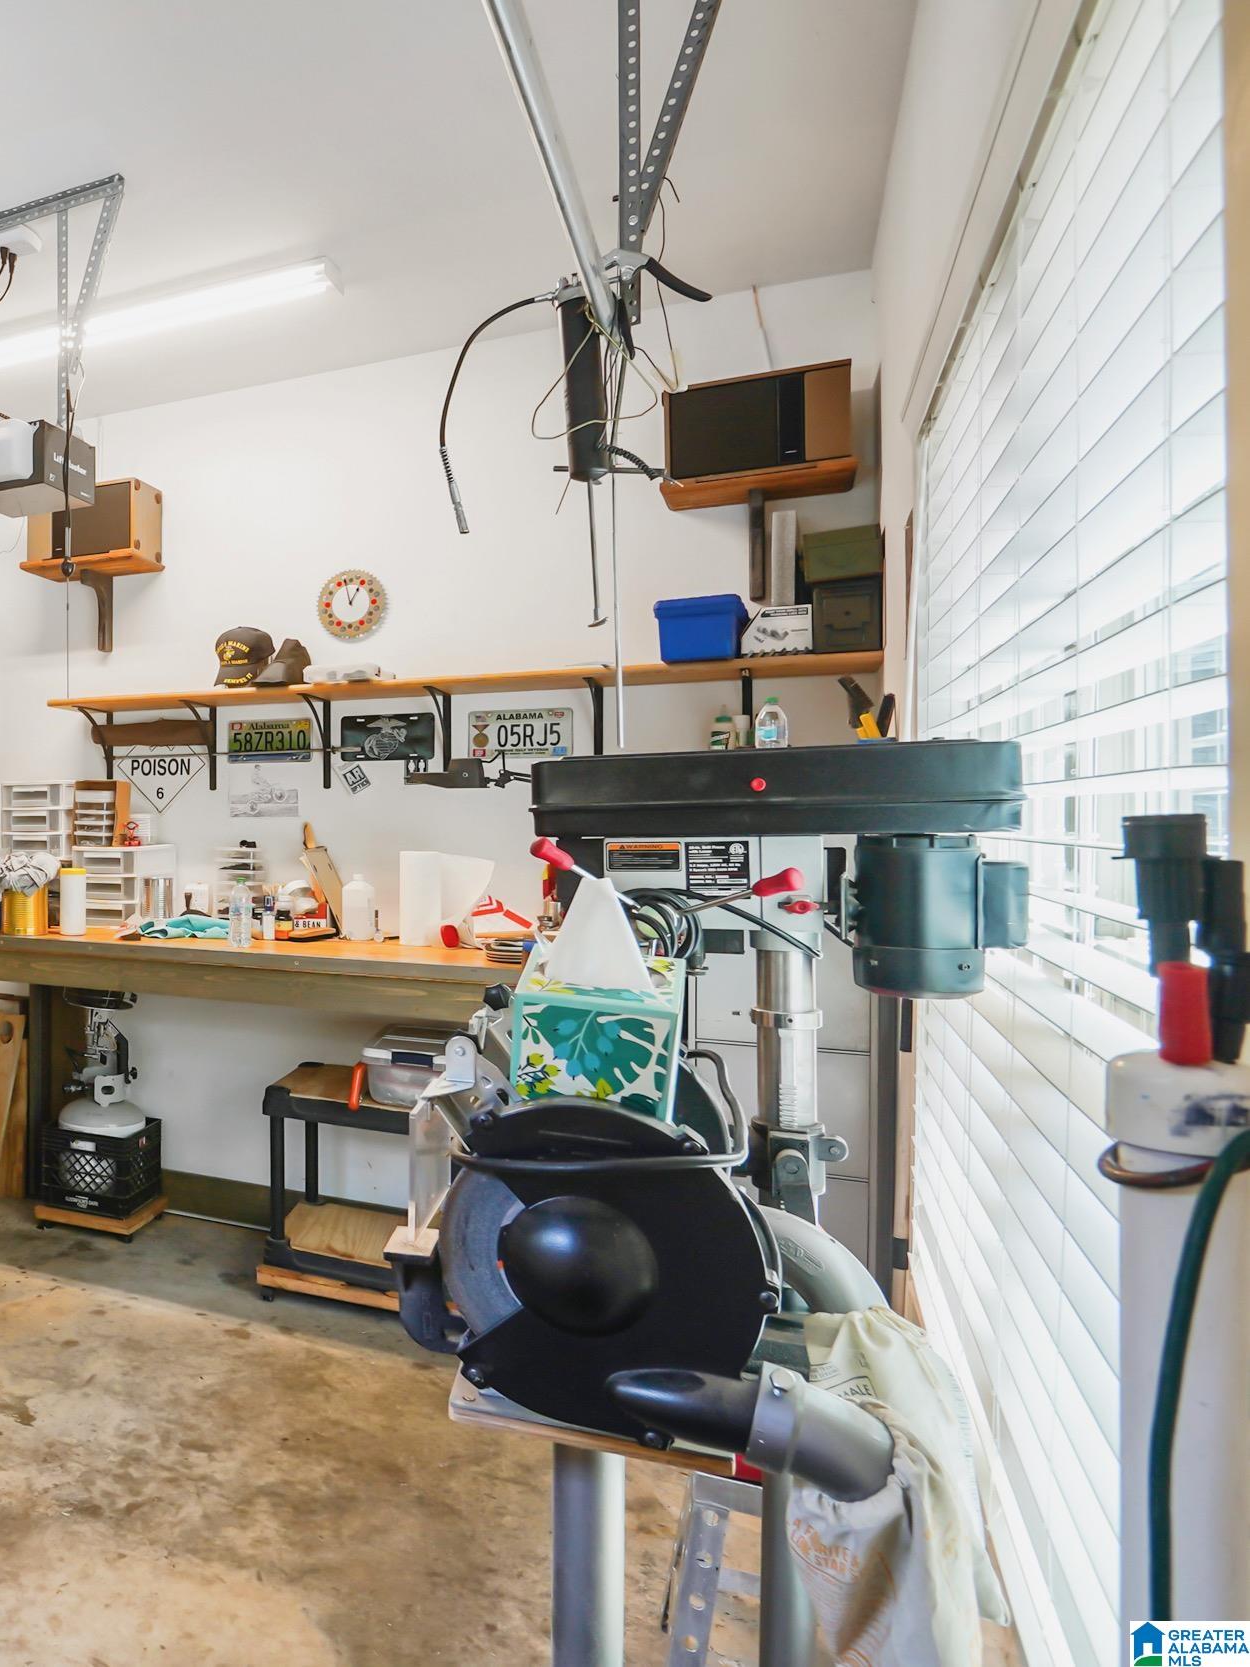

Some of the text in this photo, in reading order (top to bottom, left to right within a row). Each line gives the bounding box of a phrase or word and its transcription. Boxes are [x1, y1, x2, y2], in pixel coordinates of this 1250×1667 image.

[496, 712, 544, 720] ALABAMA
[249, 722, 289, 730] Alabama
[233, 730, 306, 752] 58ZR310
[497, 722, 561, 747] 05RJ5
[131, 758, 191, 776] POISON
[156, 787, 165, 800] 6
[294, 920, 322, 928] & BEAN
